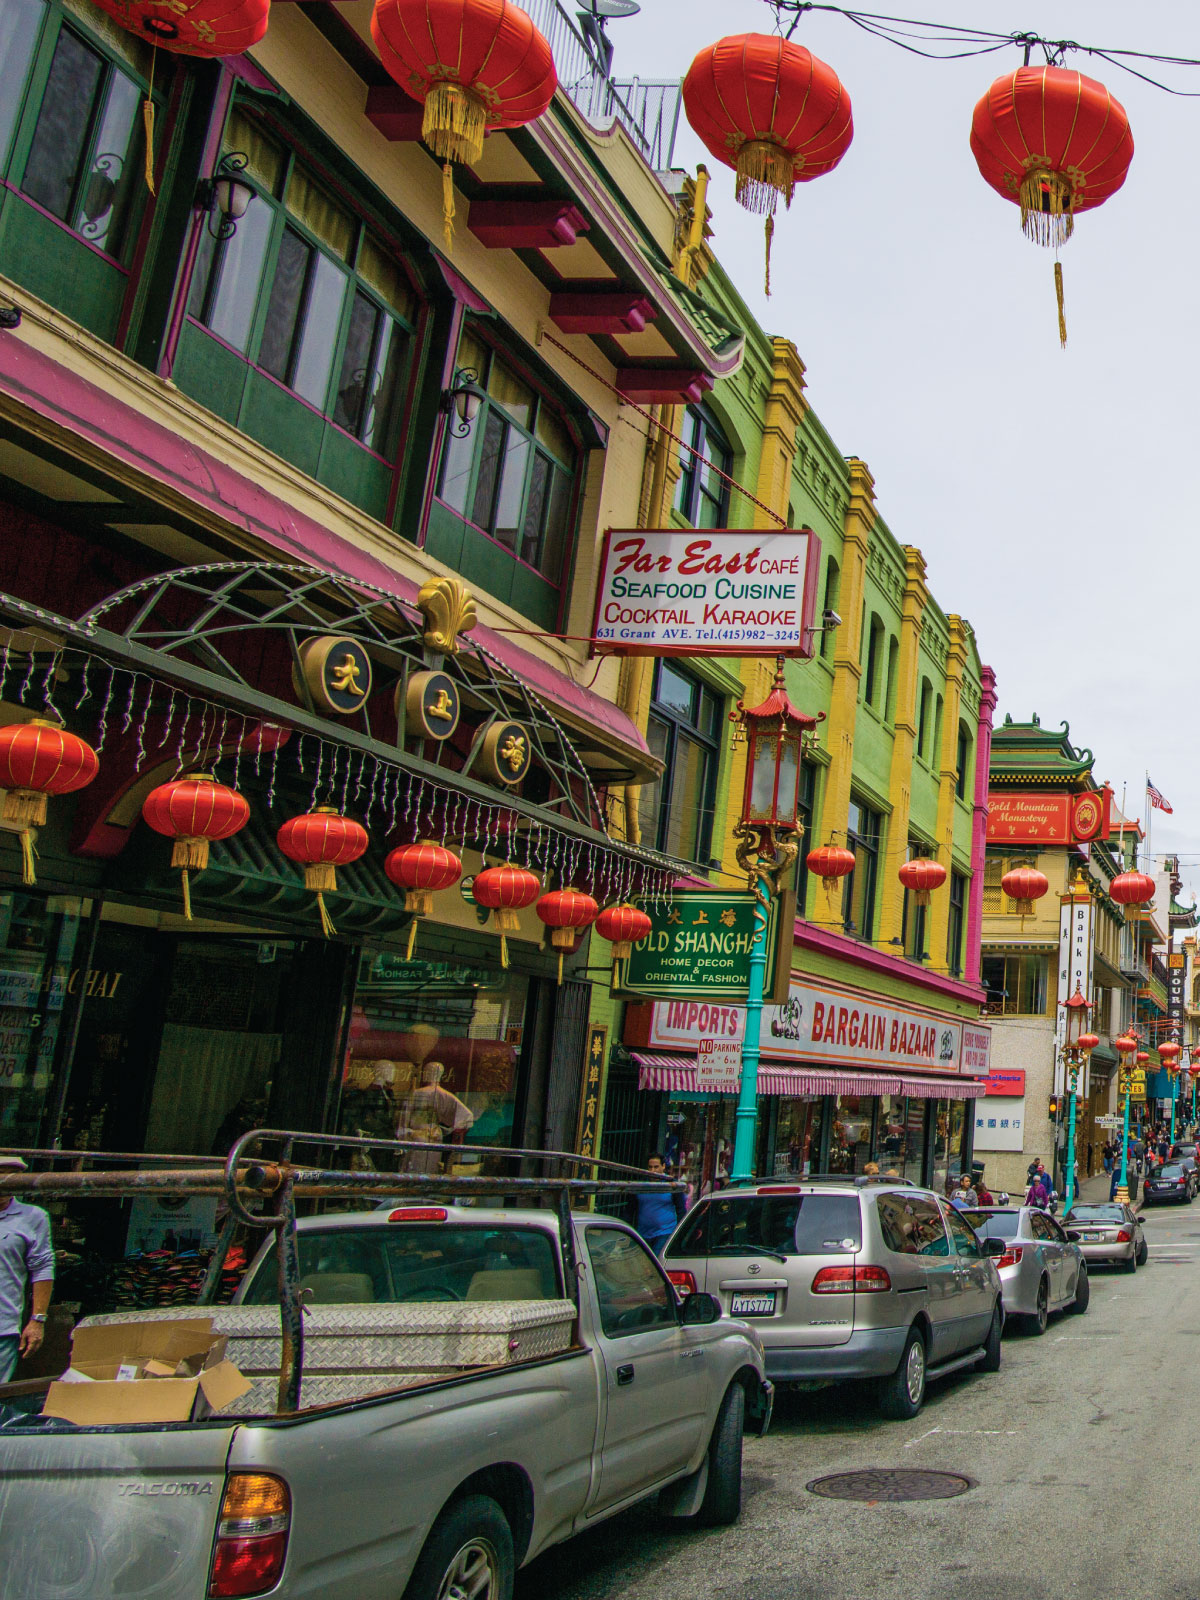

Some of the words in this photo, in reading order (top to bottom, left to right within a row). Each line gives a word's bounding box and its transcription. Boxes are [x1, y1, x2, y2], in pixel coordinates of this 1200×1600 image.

[613, 538, 672, 575] Far
[677, 539, 761, 576] East
[760, 556, 799, 574] CAFÉ
[610, 576, 707, 600] SEAFOOD
[715, 578, 796, 600] CUISINE
[604, 602, 695, 624] COCKTAIL
[702, 604, 796, 626] KARAOKE
[597, 628, 616, 638] 631
[620, 628, 656, 638] Grant
[662, 628, 692, 639] AVE.
[988, 801, 1010, 814] Gold
[1012, 802, 1060, 812] Mountain
[996, 812, 1048, 825] Monastery
[1076, 910, 1084, 958] Bank
[634, 931, 672, 953] OLD
[674, 931, 756, 955] SHANGHA
[660, 958, 694, 968] HOME
[698, 958, 734, 968] DECOR
[692, 966, 700, 974] &
[646, 972, 696, 983] ORIENTAL
[702, 974, 746, 983] FASHION
[1172, 968, 1181, 1004] FOUR
[666, 1002, 739, 1036] IMPORTS
[812, 1001, 886, 1052] BARGAIN
[889, 1020, 938, 1058] BAZAAR
[700, 1040, 713, 1053] NO
[714, 1043, 741, 1053] PARKING
[702, 1055, 707, 1064] 2
[724, 1056, 729, 1064] 6
[976, 1119, 1021, 1129] 美國銀行
[733, 1299, 774, 1312] 4YTS777
[117, 1481, 214, 1497] TACOMA
